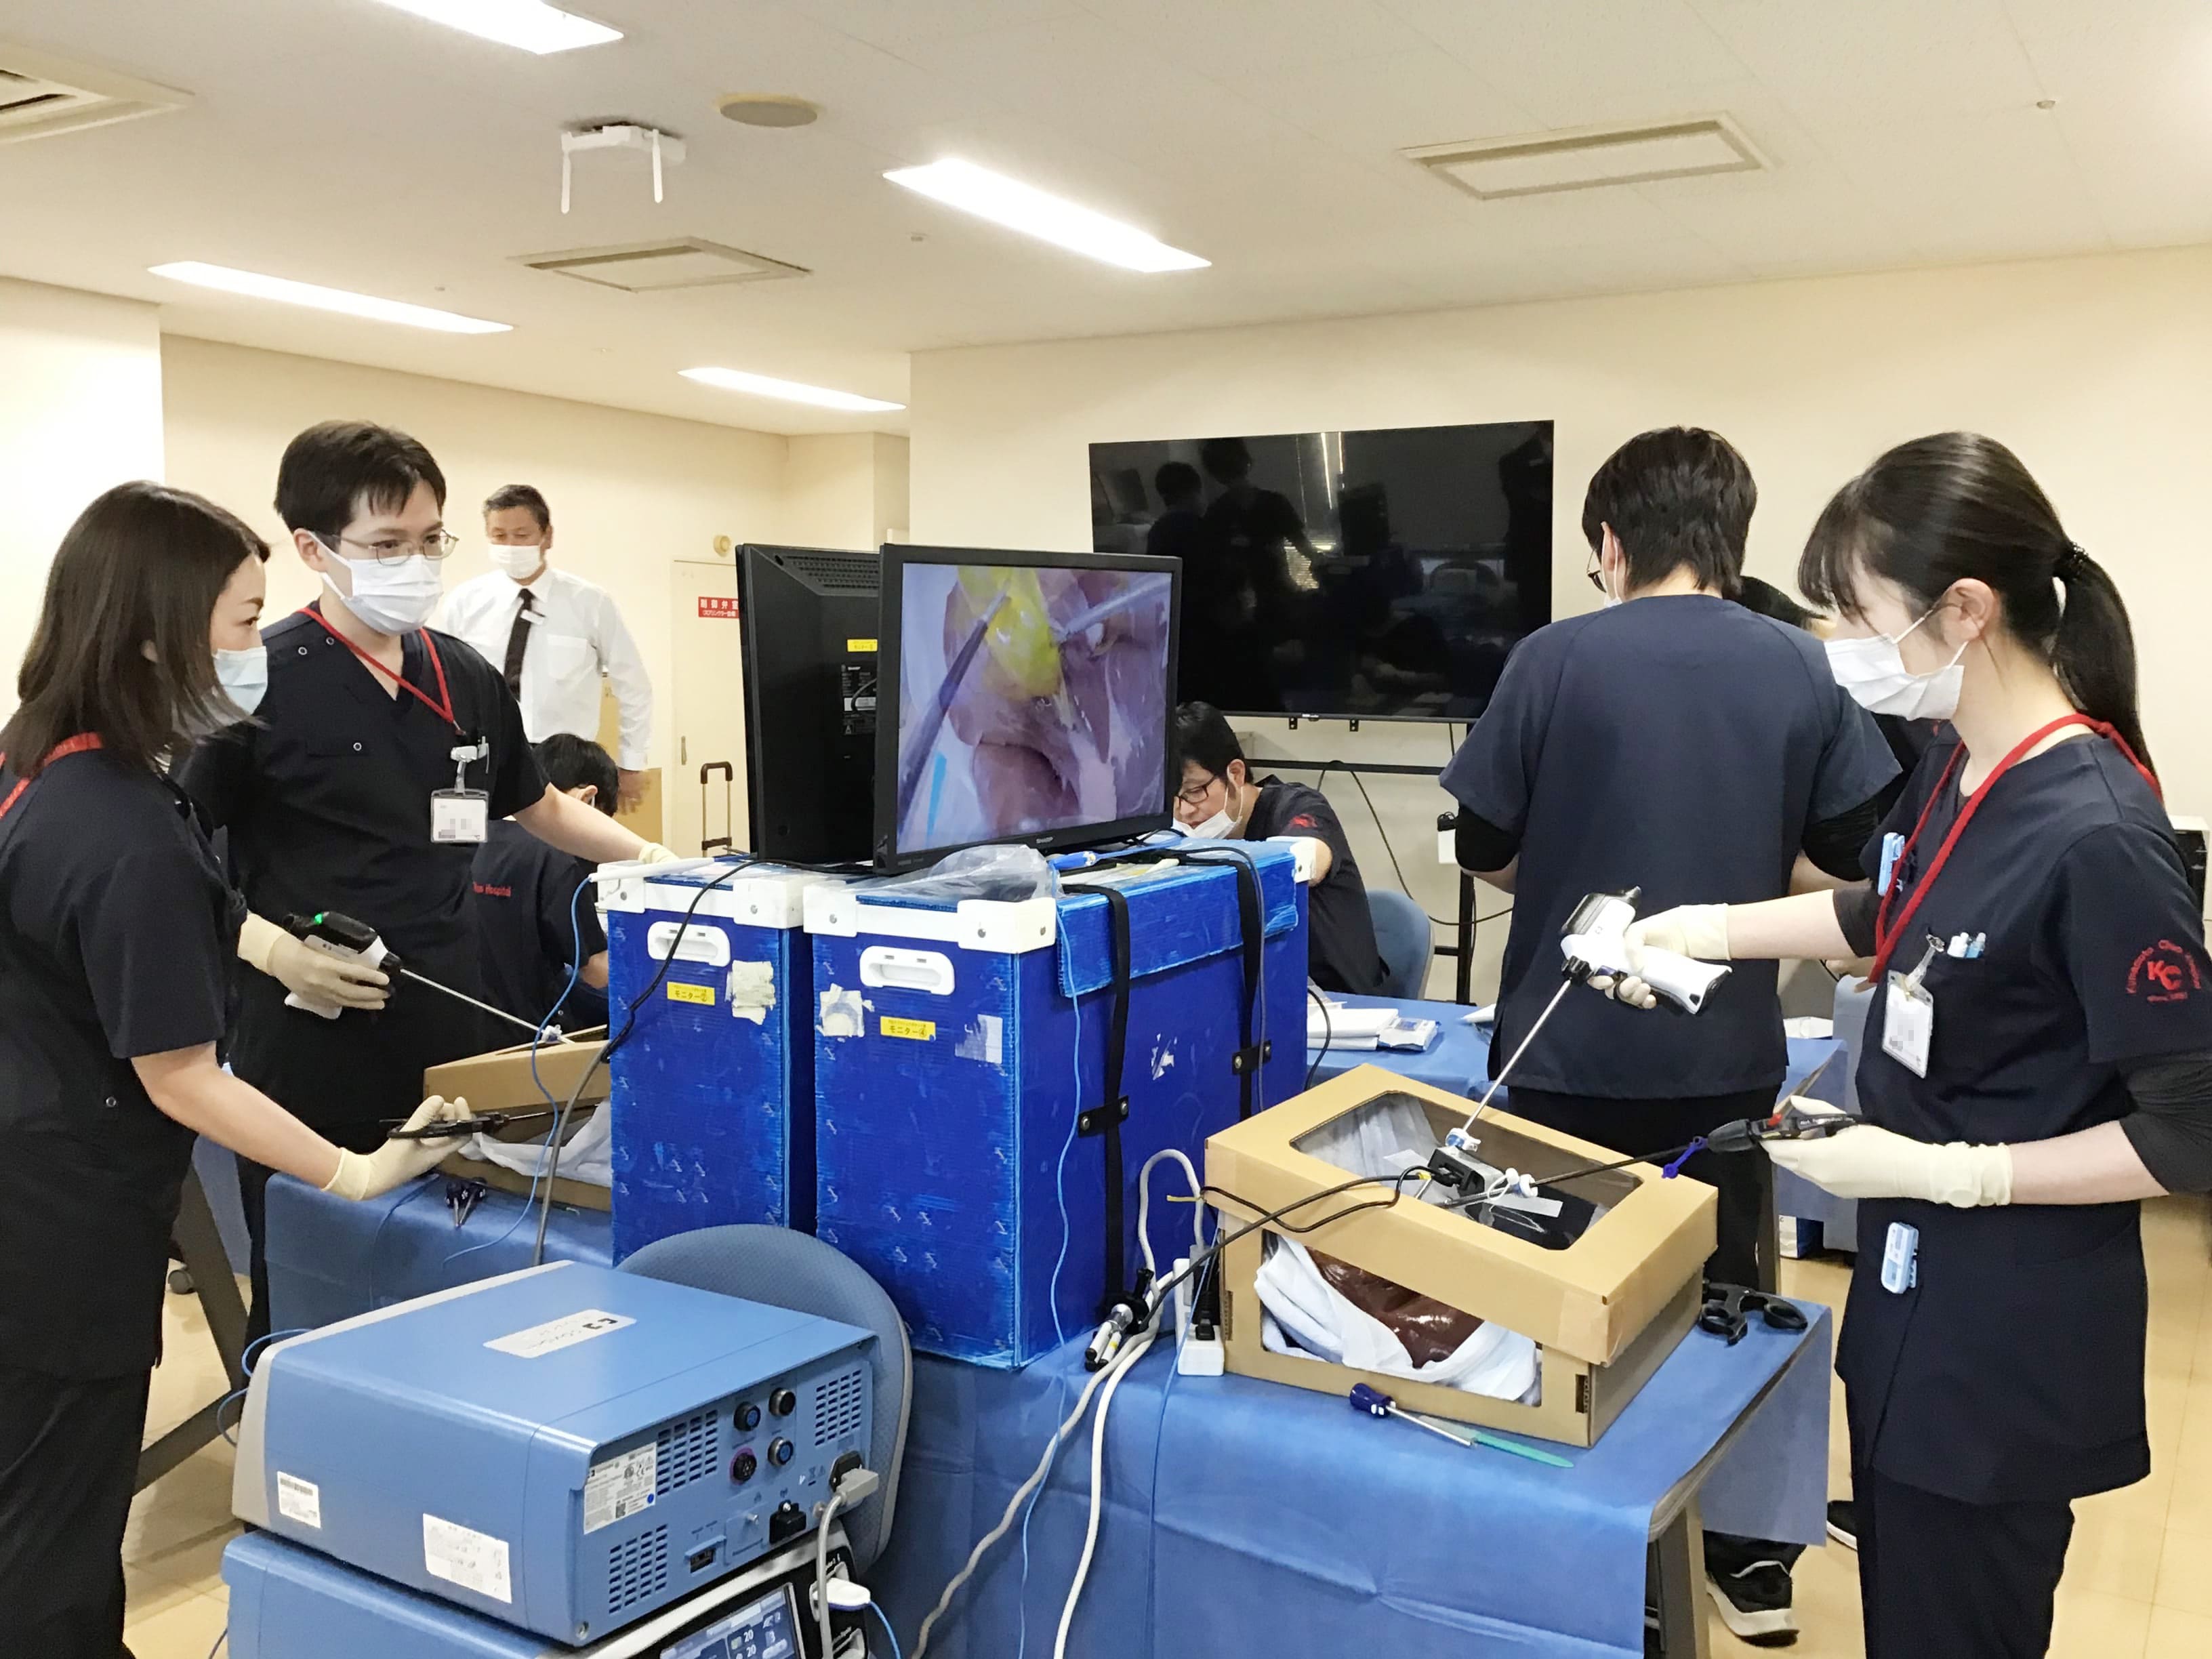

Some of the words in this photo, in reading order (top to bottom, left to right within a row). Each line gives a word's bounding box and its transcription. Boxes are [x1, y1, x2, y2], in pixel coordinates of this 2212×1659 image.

[2147, 960, 2182, 990] KC
[743, 1629, 754, 1643] 20
[746, 1643, 756, 1658] 20
